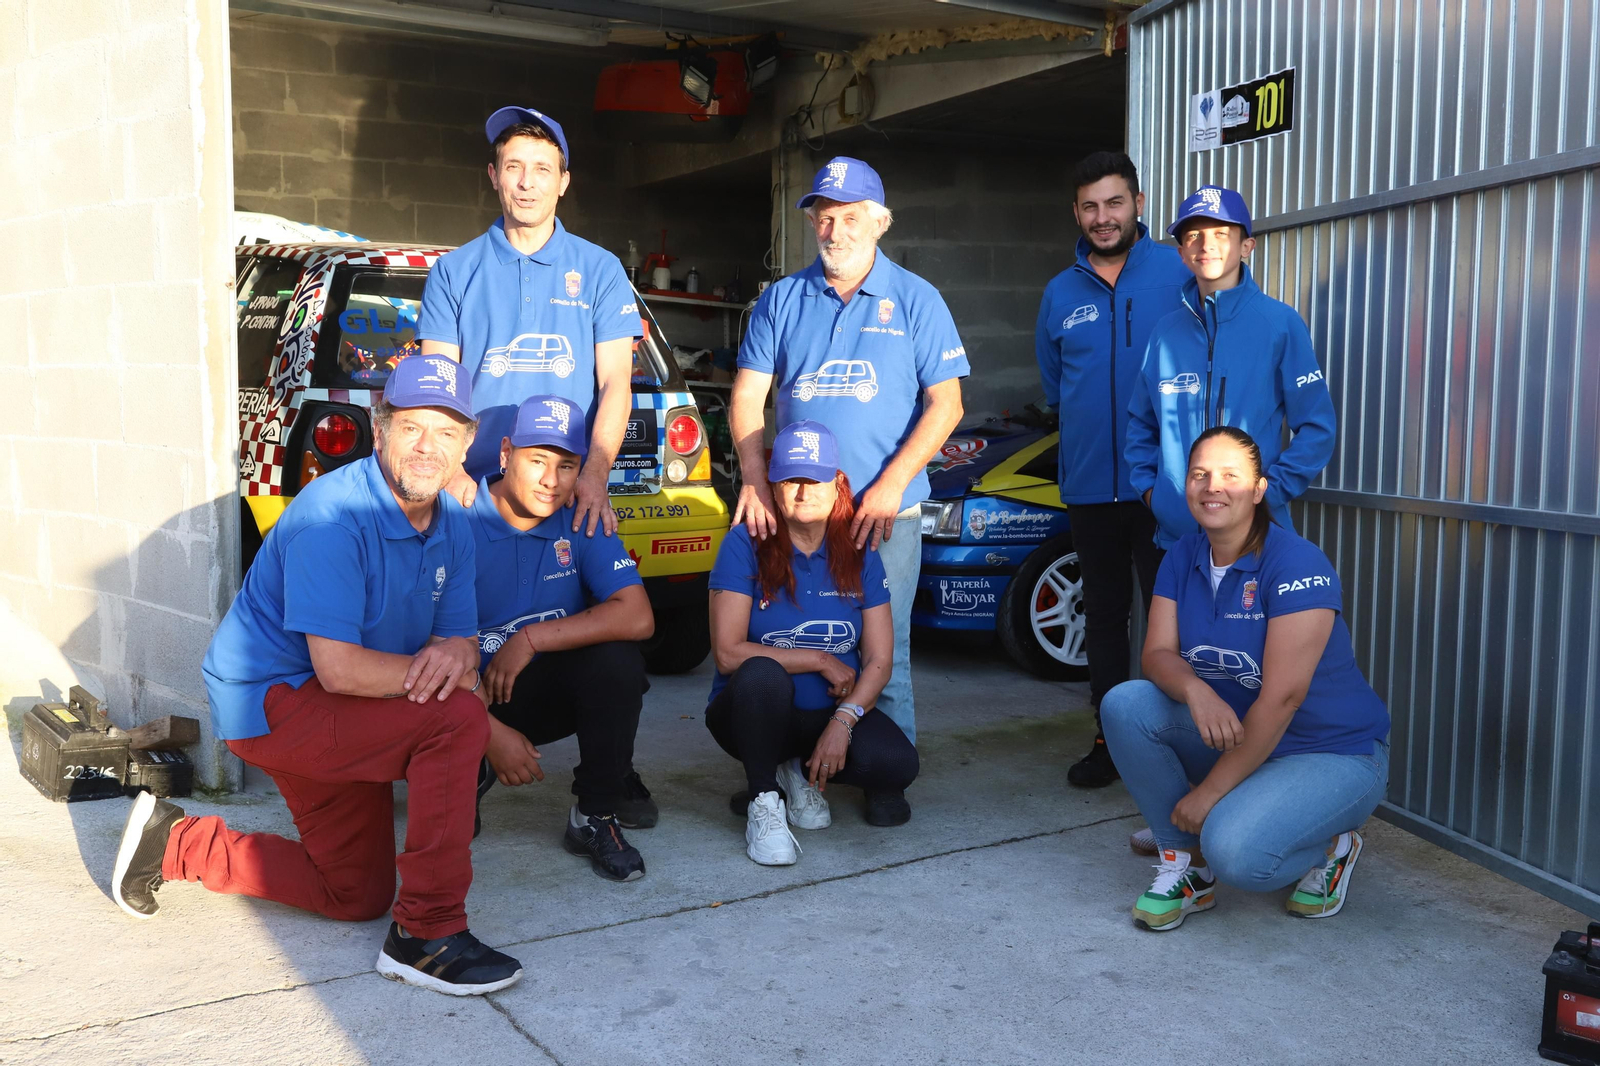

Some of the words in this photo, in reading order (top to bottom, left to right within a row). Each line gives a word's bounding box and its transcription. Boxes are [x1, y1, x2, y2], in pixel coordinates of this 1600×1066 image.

[1255, 78, 1285, 131] 101
[624, 431, 637, 439] OS
[639, 505, 664, 518] 172
[666, 504, 690, 516] 991
[651, 536, 711, 555] PIRELLI
[543, 571, 564, 581] Concello
[951, 578, 990, 589] TAPERÍA
[1278, 576, 1331, 595] PATRY
[941, 587, 996, 608] MANYAR
